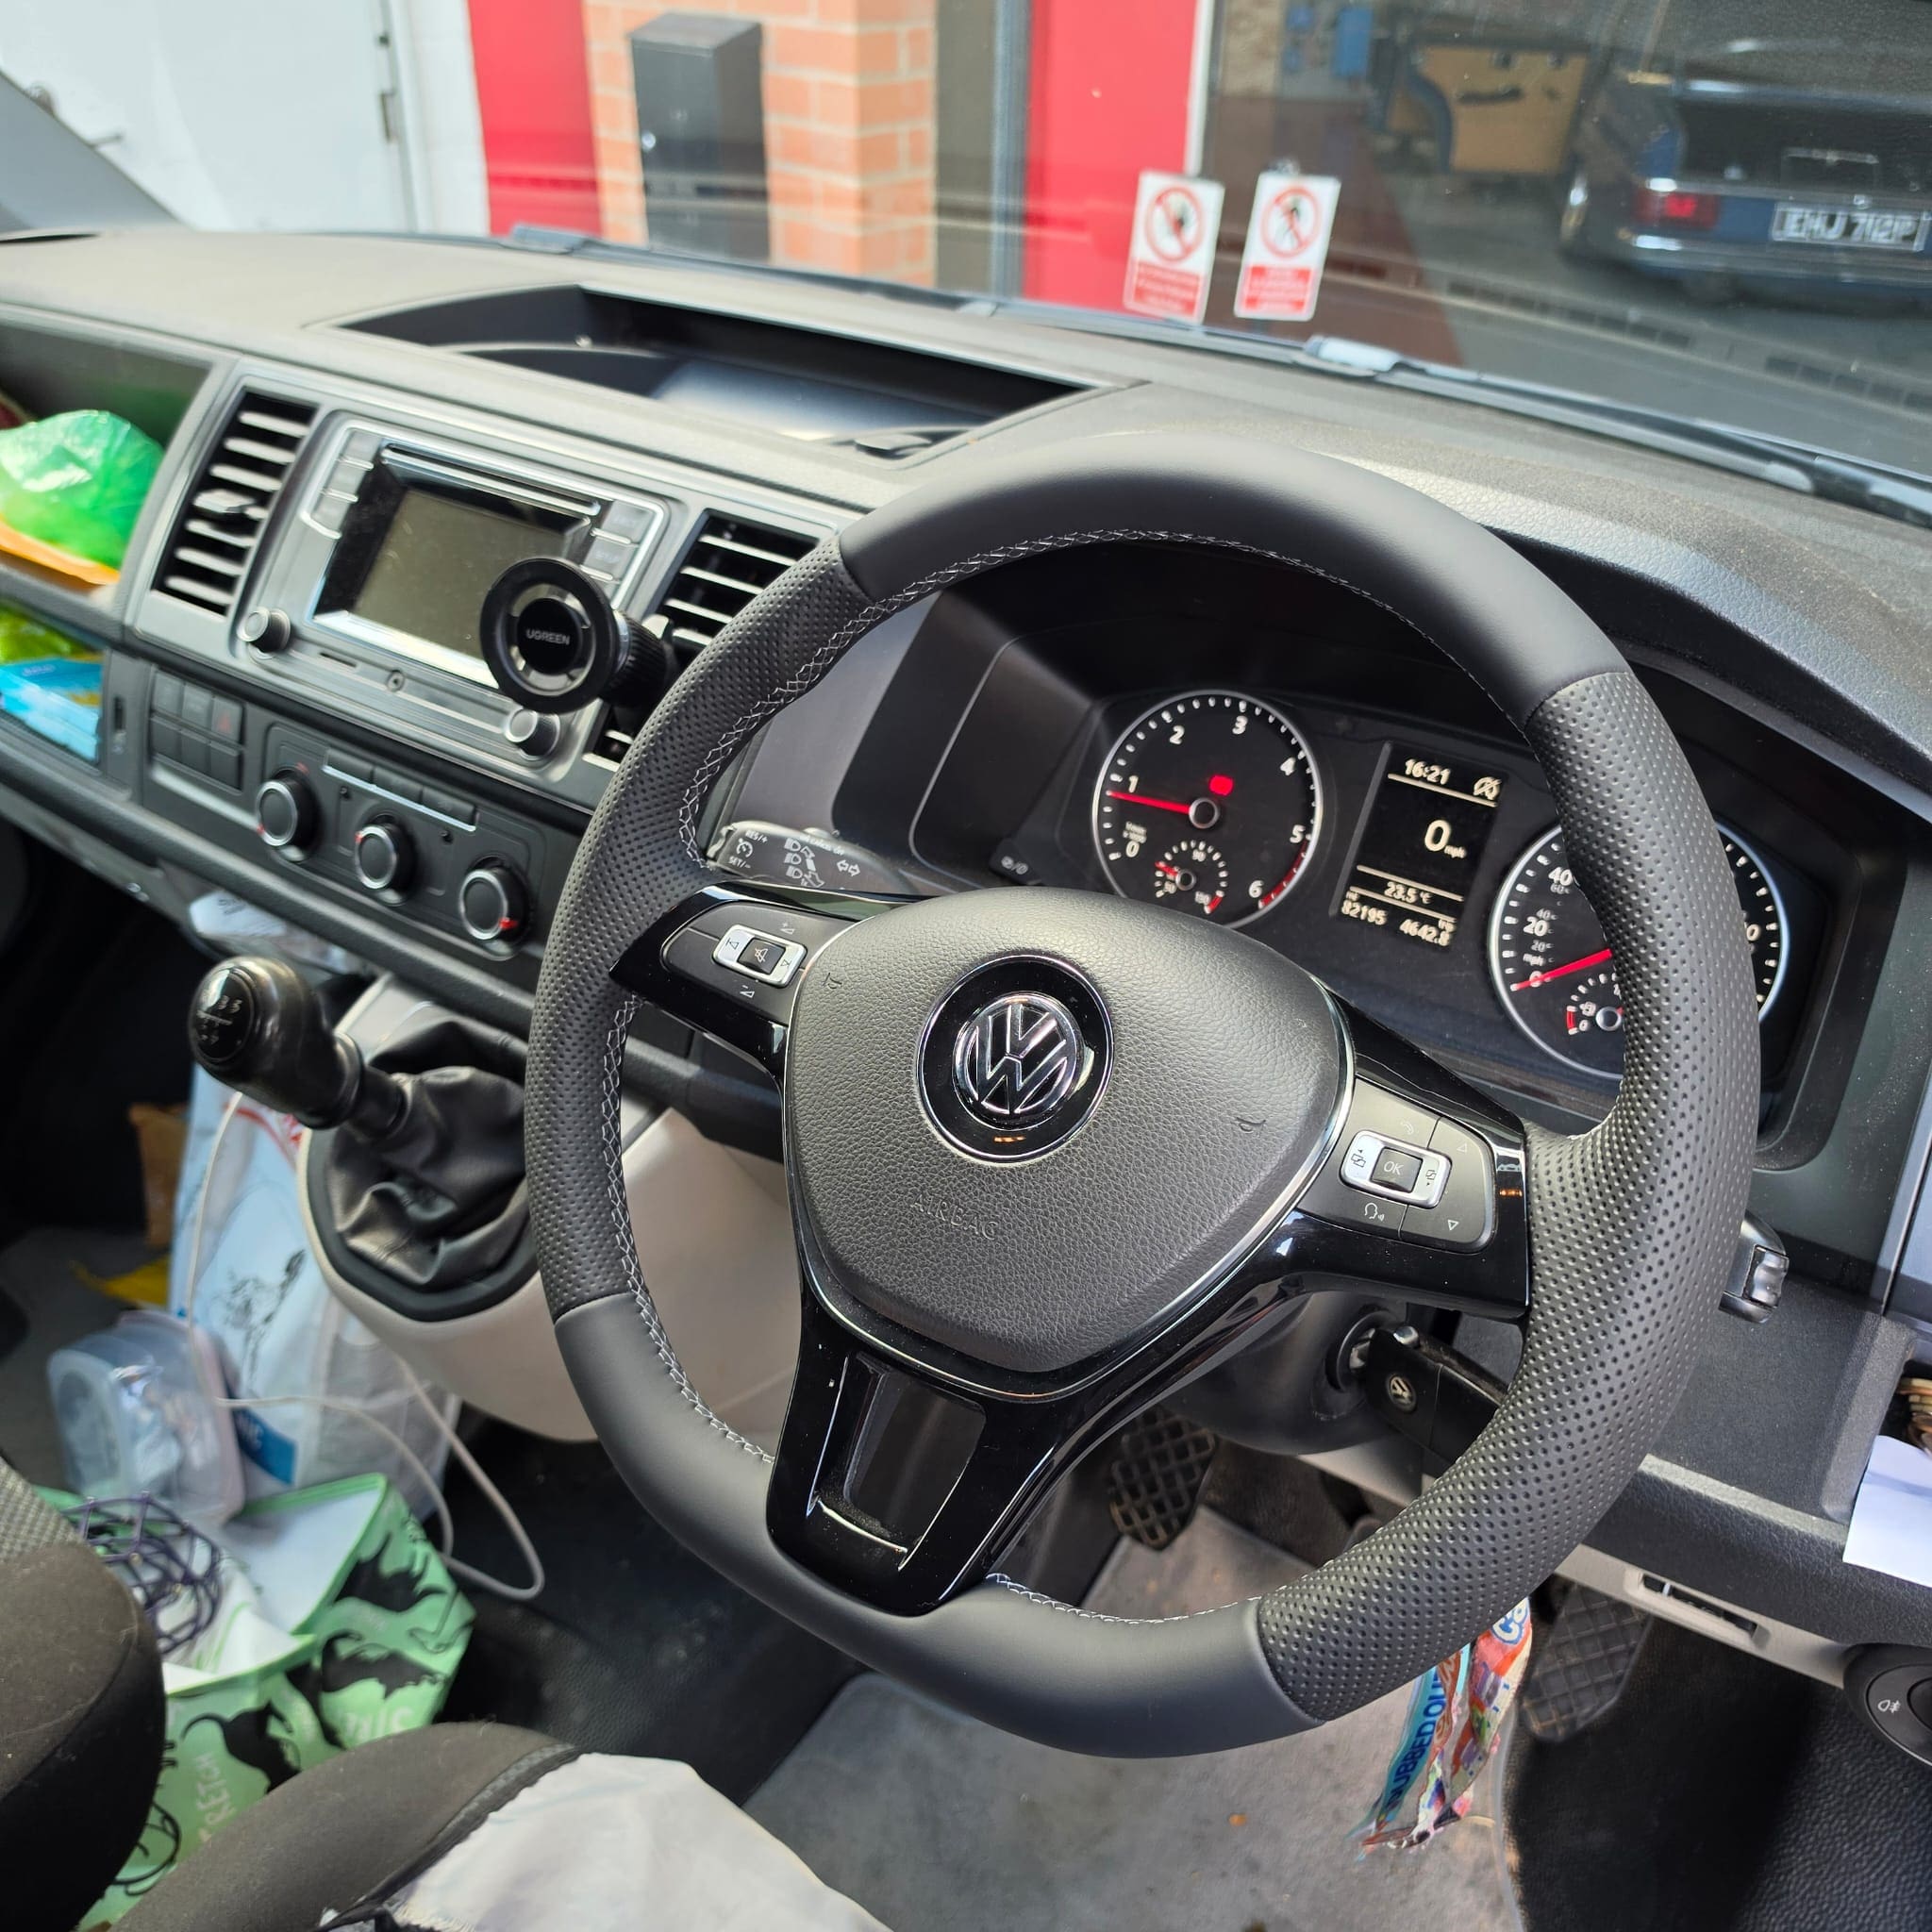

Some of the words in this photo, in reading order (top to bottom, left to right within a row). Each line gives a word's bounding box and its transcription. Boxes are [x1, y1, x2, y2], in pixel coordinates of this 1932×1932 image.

[525, 629, 571, 645] UGREEN
[1169, 724, 1185, 745] 2
[1232, 715, 1248, 735] 3
[1279, 757, 1295, 775] 4
[1404, 758, 1452, 785] 16:21
[1127, 774, 1140, 793] 1
[1290, 824, 1307, 844] 5
[1424, 819, 1451, 852] 0
[1125, 841, 1140, 858] 0
[1548, 866, 1574, 887] 40
[1249, 880, 1264, 898] 6
[1384, 881, 1419, 903] 23.5
[1341, 900, 1388, 926] 82195
[1523, 916, 1550, 937] 20
[1383, 1160, 1405, 1176] OK
[909, 1191, 1000, 1241] AIRBAG
